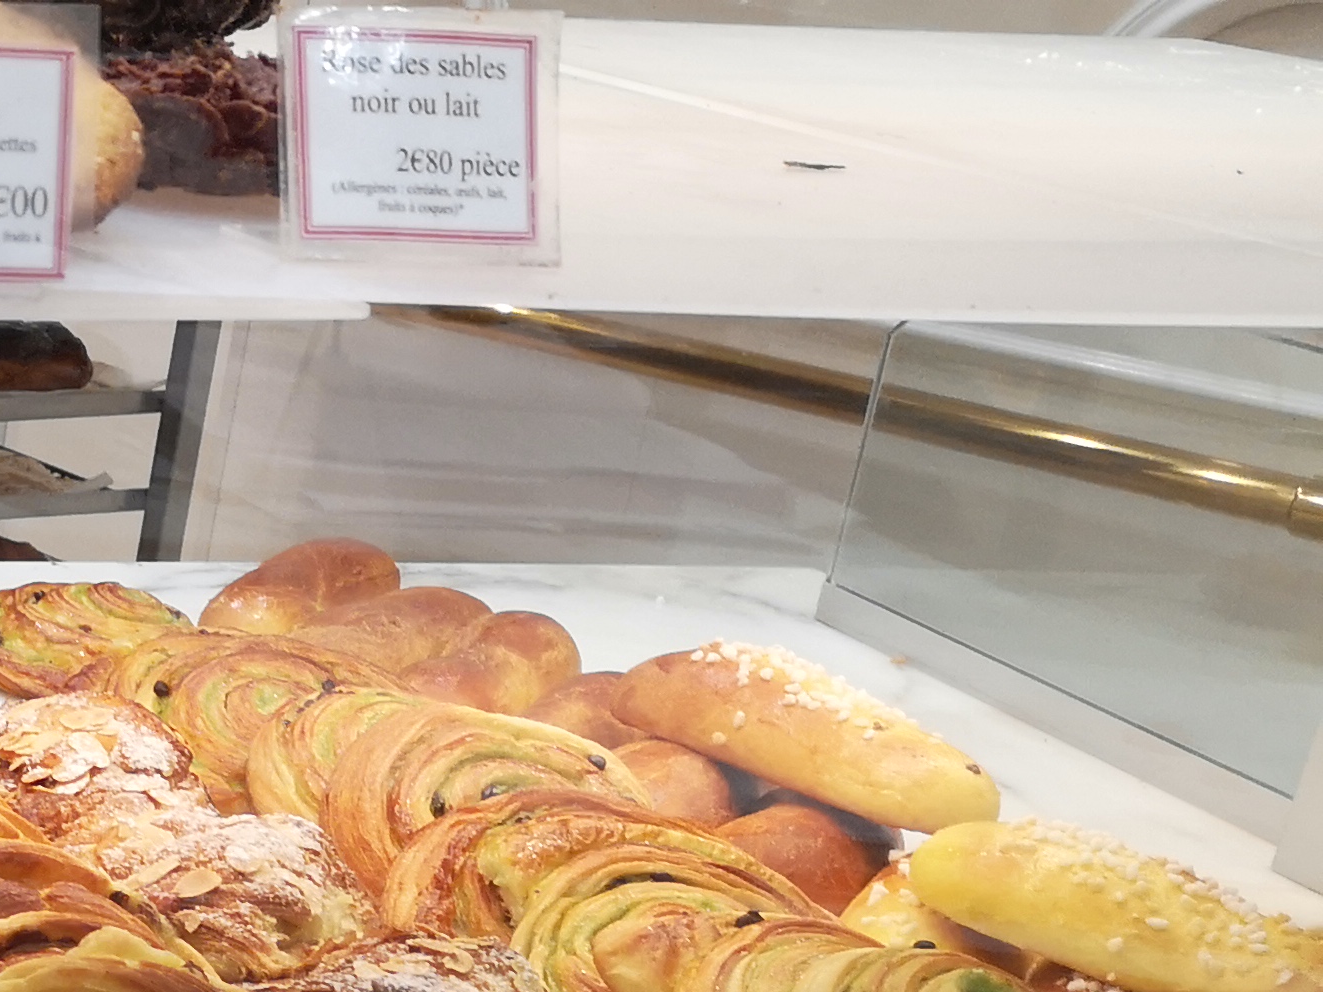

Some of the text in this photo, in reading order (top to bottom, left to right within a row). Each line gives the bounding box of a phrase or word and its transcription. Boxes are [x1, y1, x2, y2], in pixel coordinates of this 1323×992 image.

[390, 53, 430, 75] des
[438, 54, 508, 80] sables
[351, 88, 481, 118] noir ou lait
[397, 148, 521, 182] 2€80 pièce
